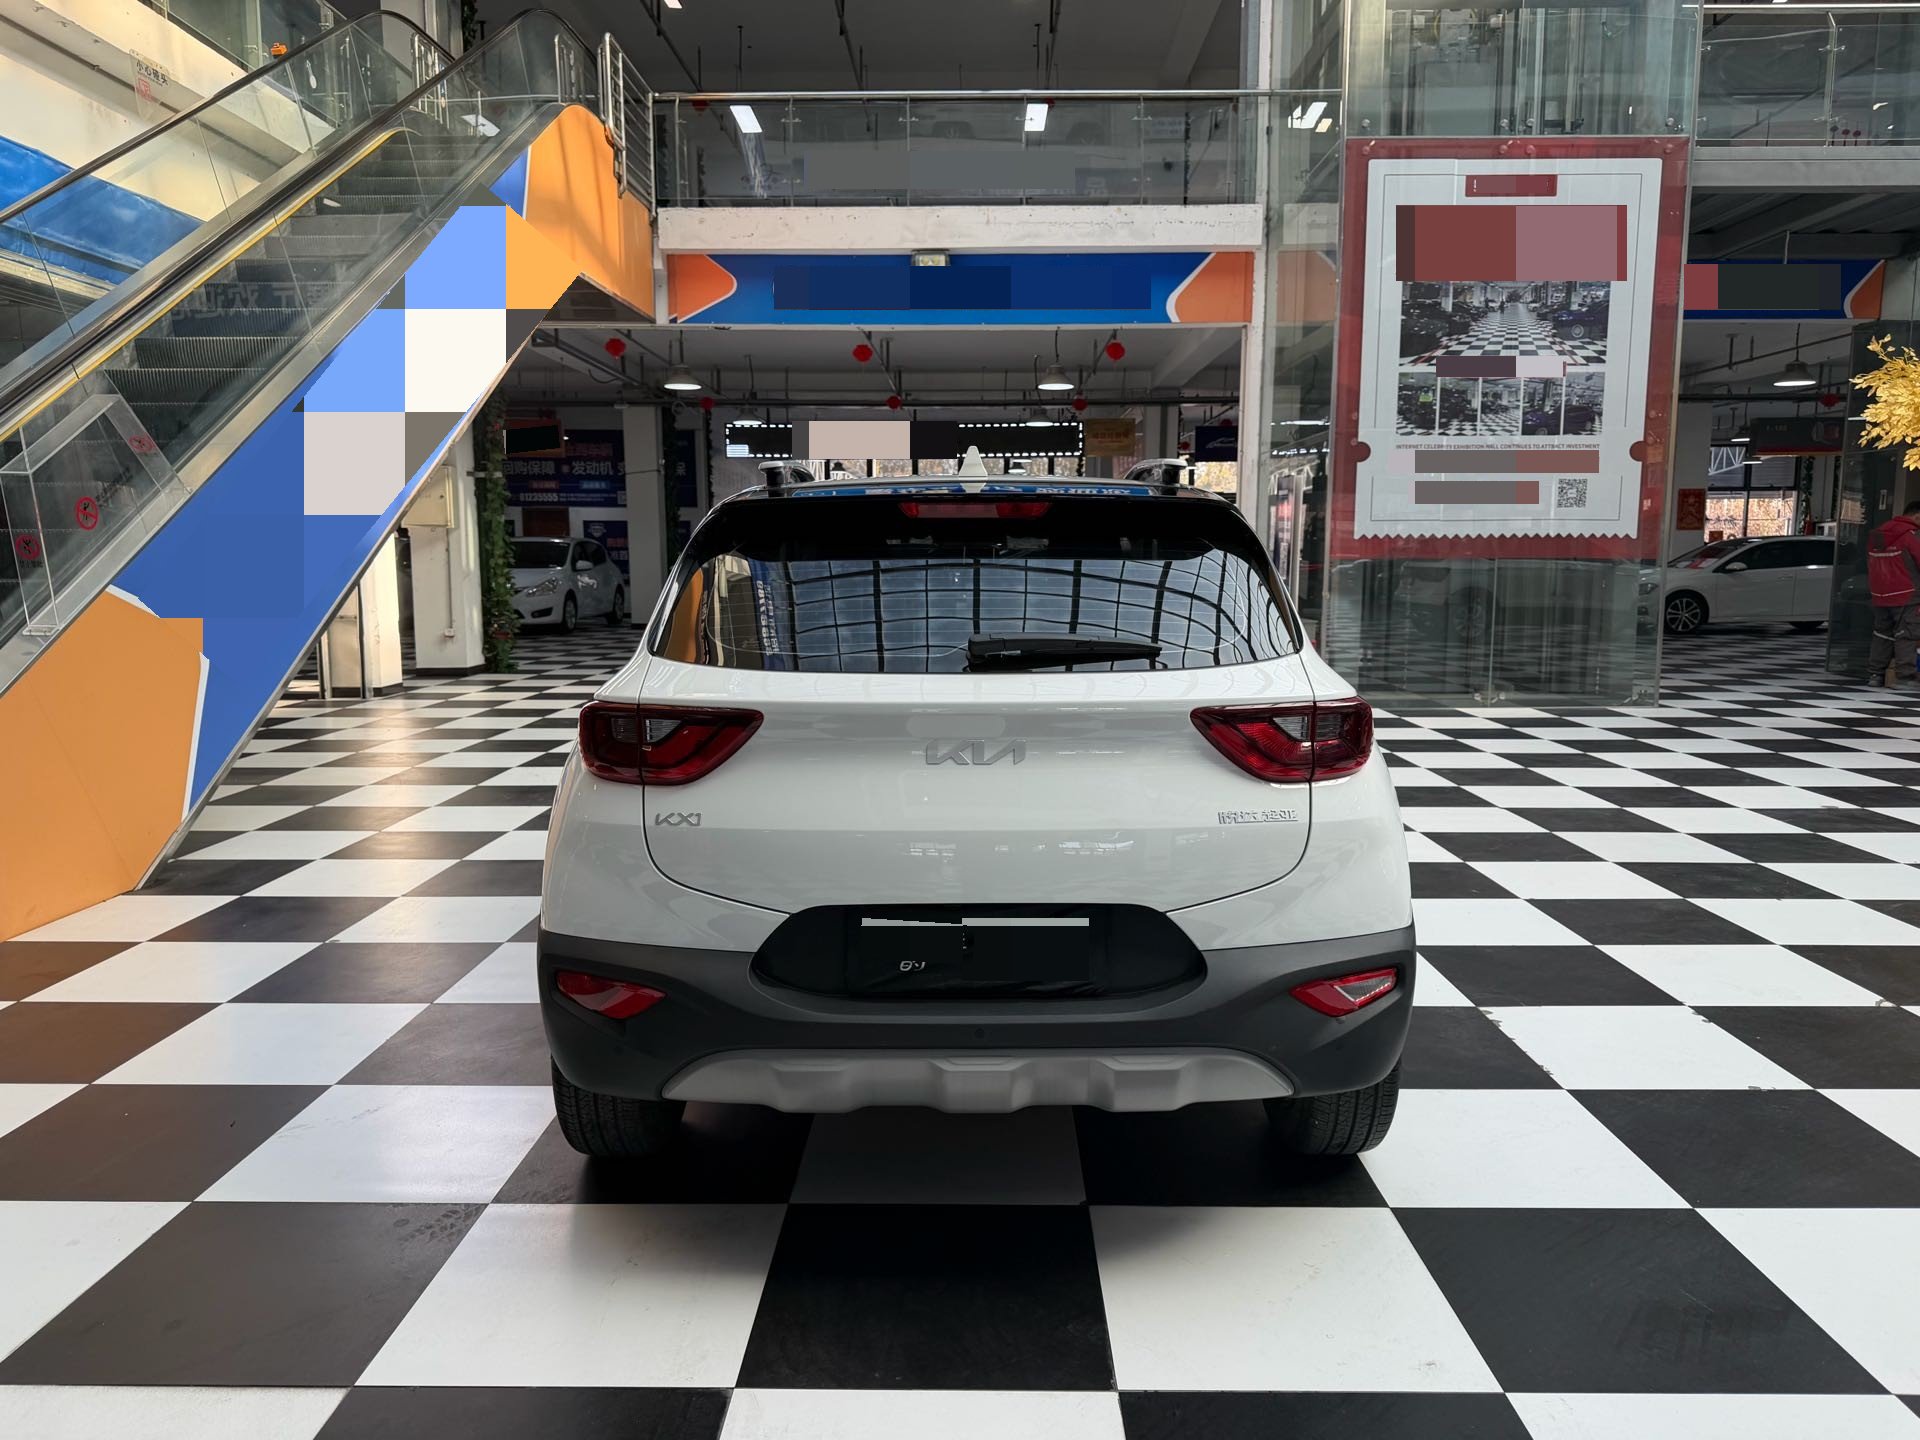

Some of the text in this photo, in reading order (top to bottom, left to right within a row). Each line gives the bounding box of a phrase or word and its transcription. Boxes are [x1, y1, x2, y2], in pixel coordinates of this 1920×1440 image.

[571, 460, 614, 475] 发动机
[926, 739, 1026, 765] KIA
[655, 812, 702, 827] KX1
